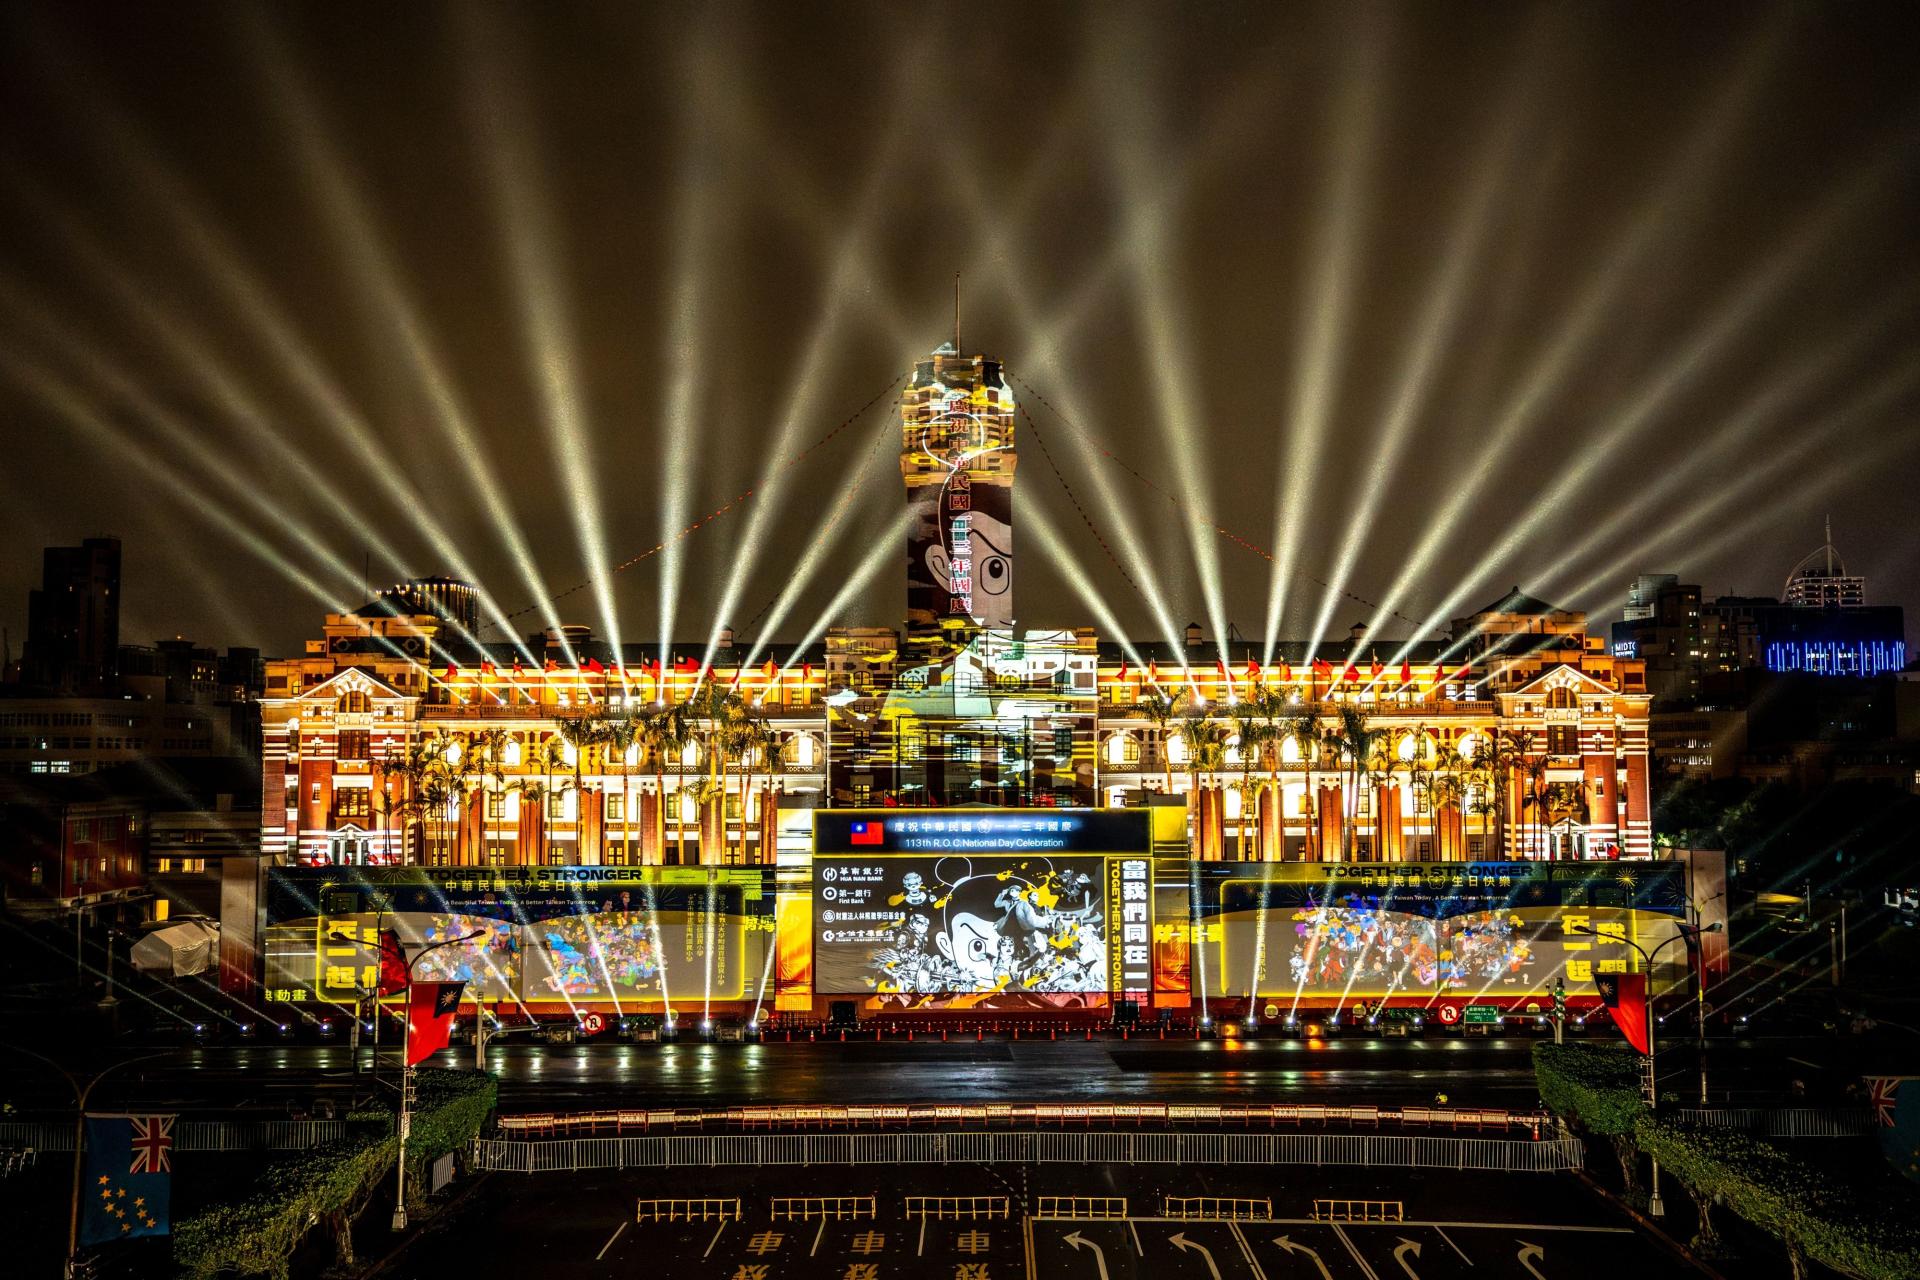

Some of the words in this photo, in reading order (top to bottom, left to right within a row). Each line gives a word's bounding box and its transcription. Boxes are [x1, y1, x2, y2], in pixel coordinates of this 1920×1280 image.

[894, 820, 972, 833] 慶祝中華民國
[994, 821, 1072, 832] 一一三年國慶
[905, 838, 931, 847] 113th
[962, 838, 997, 847] National
[998, 838, 1015, 849] Day
[1016, 838, 1064, 848] Celebration
[428, 869, 534, 881] TOGETHER,
[537, 869, 642, 880] STRONGER
[1321, 866, 1427, 878] TOGETHER,
[1430, 866, 1532, 877] STRONGER
[445, 880, 506, 892] 中華民國
[537, 880, 599, 892] 生日快樂
[1361, 876, 1420, 887] 中華民國
[1452, 876, 1511, 887] 生日快樂
[839, 889, 871, 897] 第一銀行
[1111, 860, 1121, 933] TOGETHER,
[1123, 860, 1148, 1007] 當我們同在一起
[1112, 936, 1122, 1001] STRONGE
